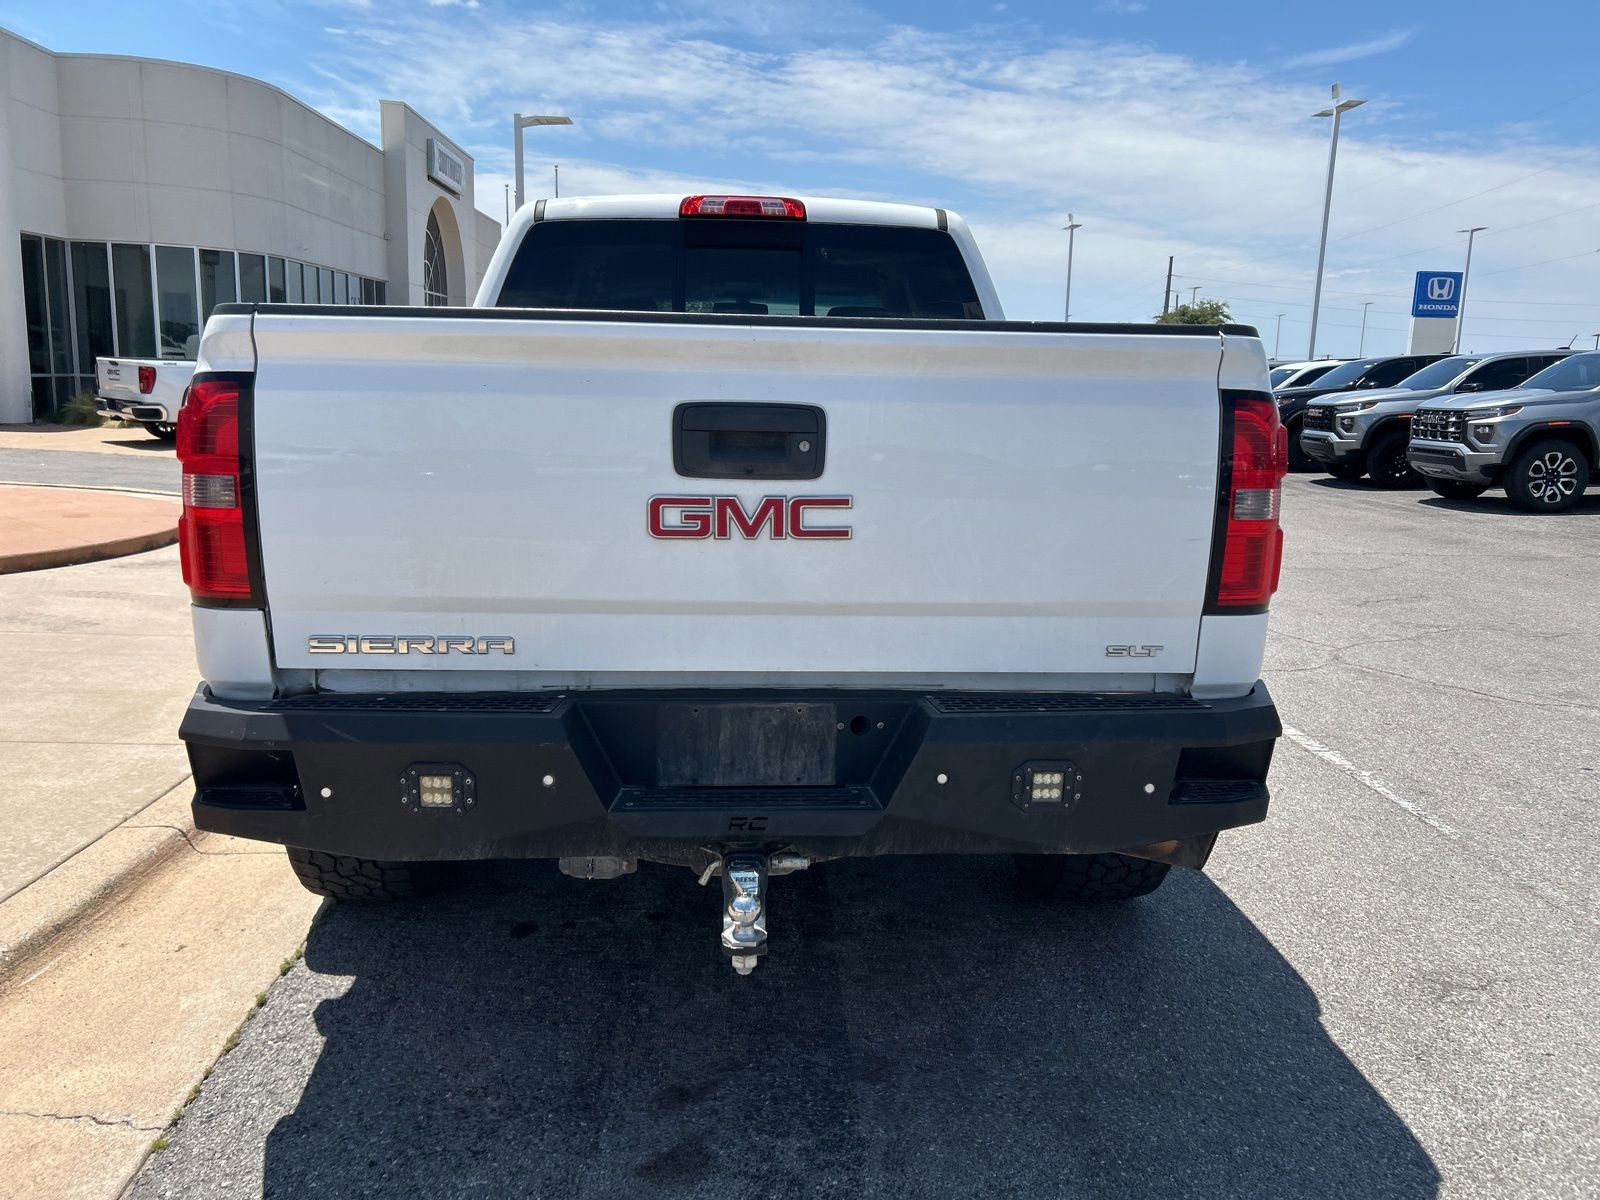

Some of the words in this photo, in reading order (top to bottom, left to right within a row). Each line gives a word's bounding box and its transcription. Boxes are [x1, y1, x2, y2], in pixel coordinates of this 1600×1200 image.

[647, 494, 853, 540] GMC
[308, 634, 515, 655] SIERRA
[1105, 645, 1164, 658] SLT
[728, 816, 769, 831] RC
